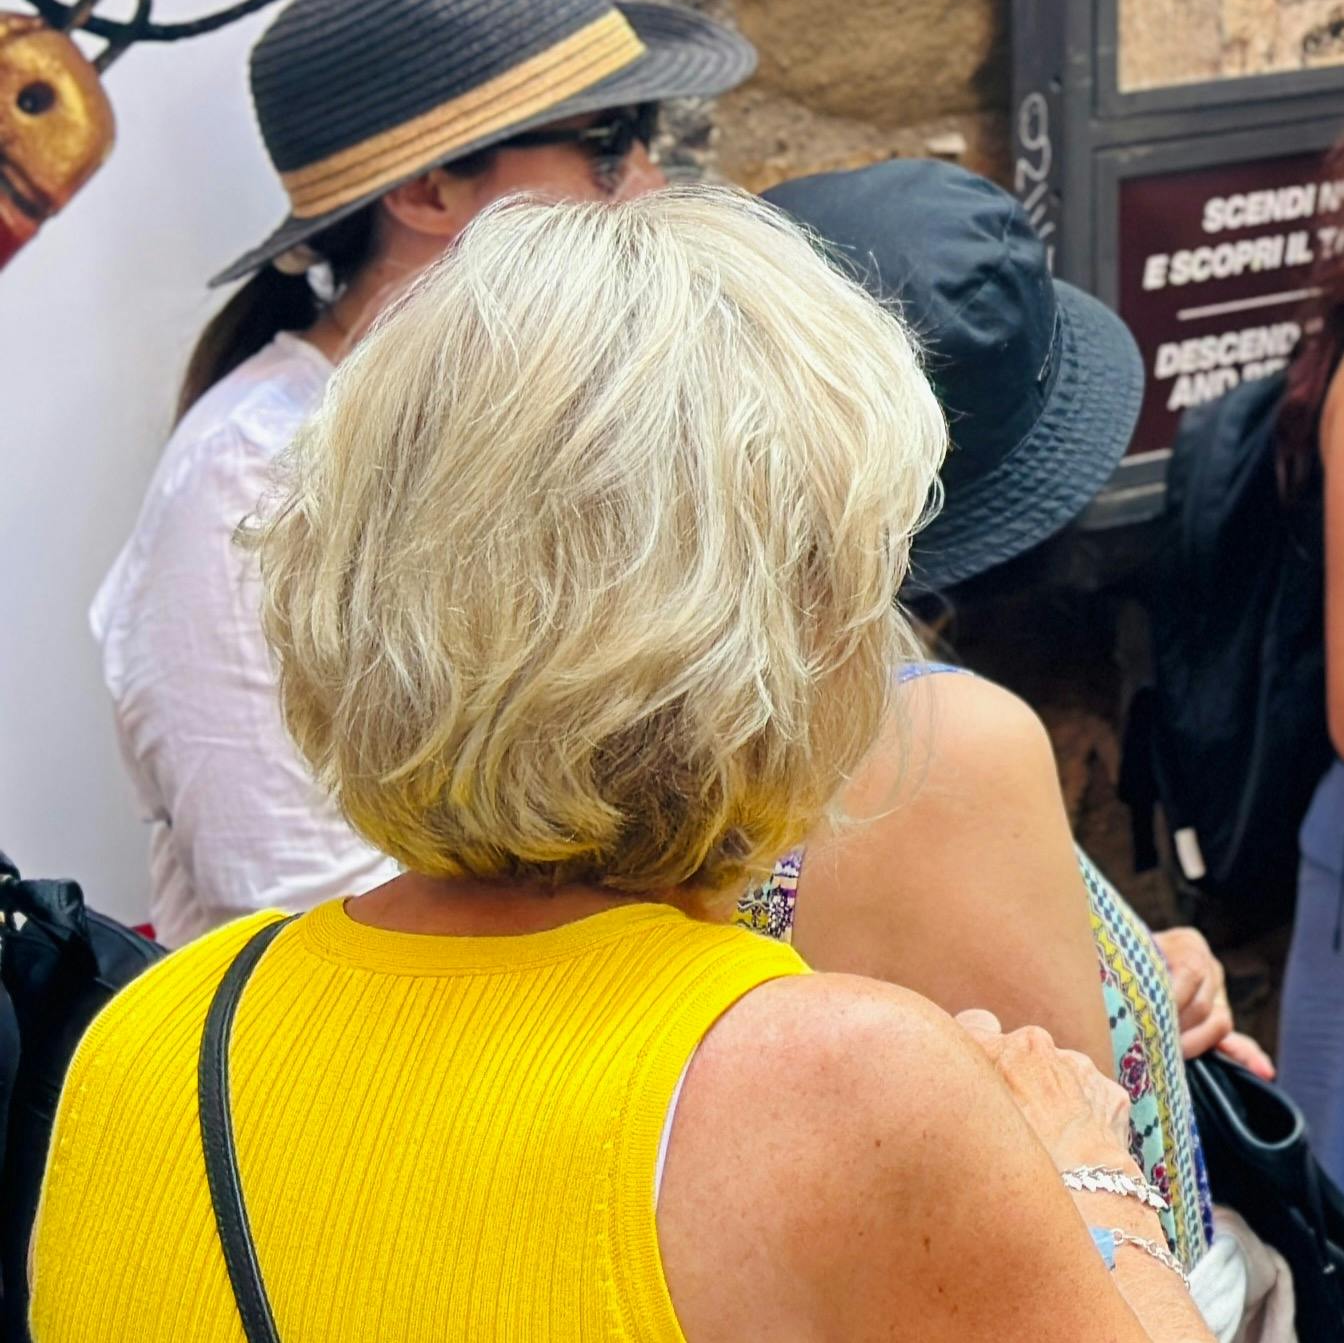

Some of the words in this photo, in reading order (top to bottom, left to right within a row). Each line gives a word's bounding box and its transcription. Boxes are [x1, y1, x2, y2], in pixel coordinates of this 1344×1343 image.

[1202, 181, 1317, 234] SCENDI
[1142, 253, 1169, 291] E
[1169, 234, 1285, 287] SCOPRI
[1284, 229, 1315, 268] IL
